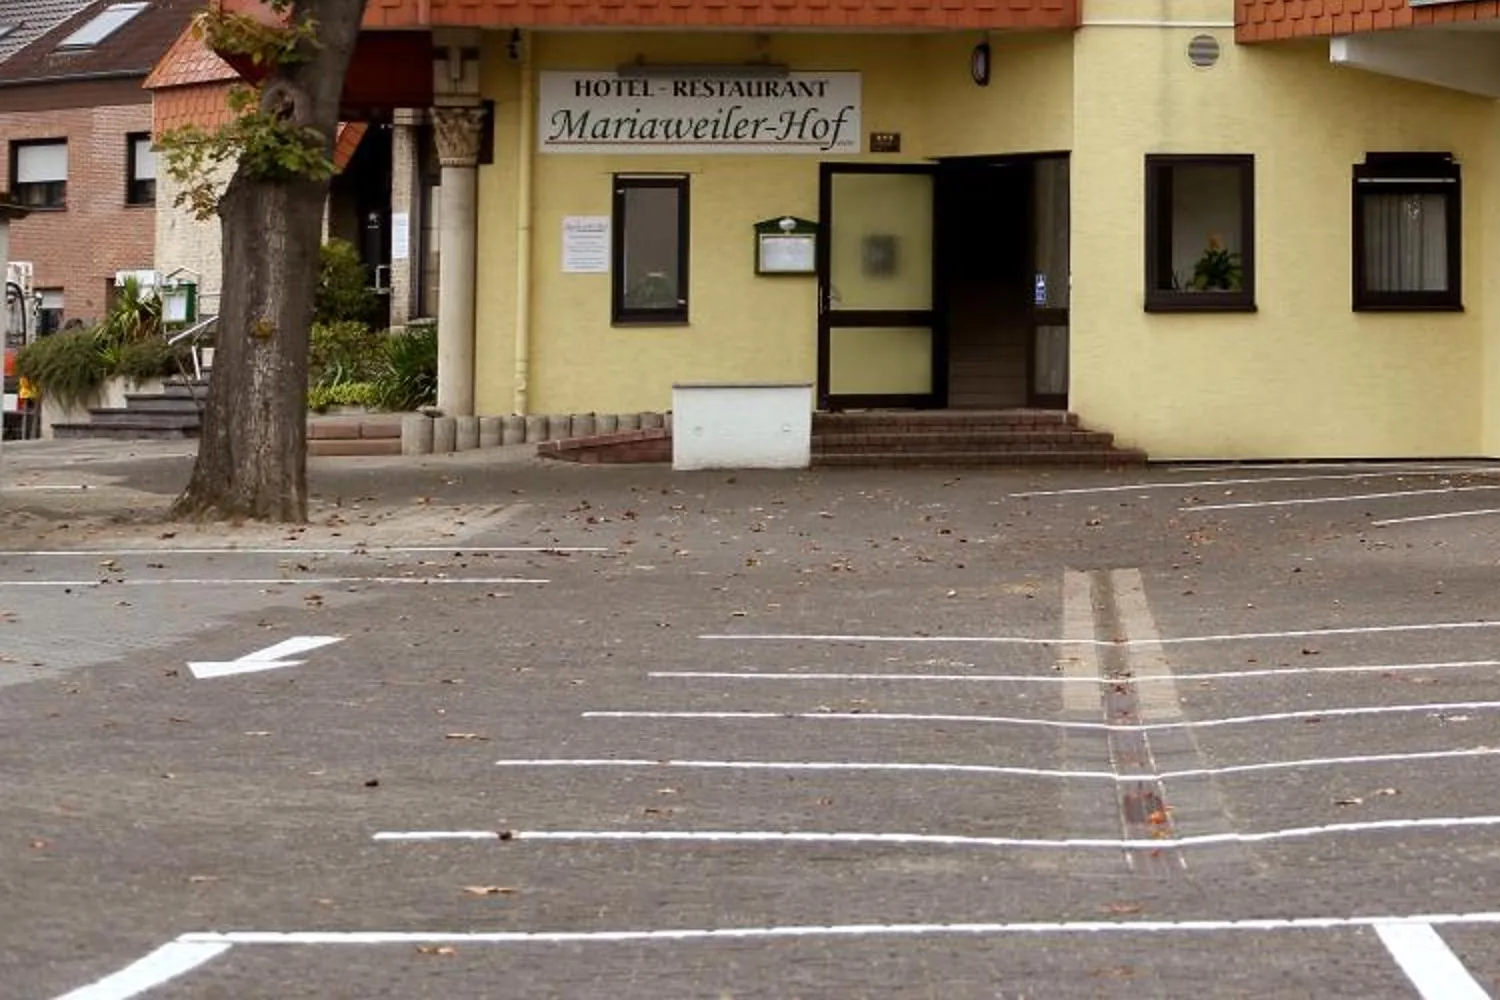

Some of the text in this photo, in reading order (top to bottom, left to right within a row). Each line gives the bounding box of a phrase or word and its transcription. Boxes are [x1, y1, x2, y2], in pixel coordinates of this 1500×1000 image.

[574, 79, 653, 97] HOTEL
[672, 79, 829, 97] RESTAURANT
[550, 106, 854, 150] Mariaweiler-Hof
